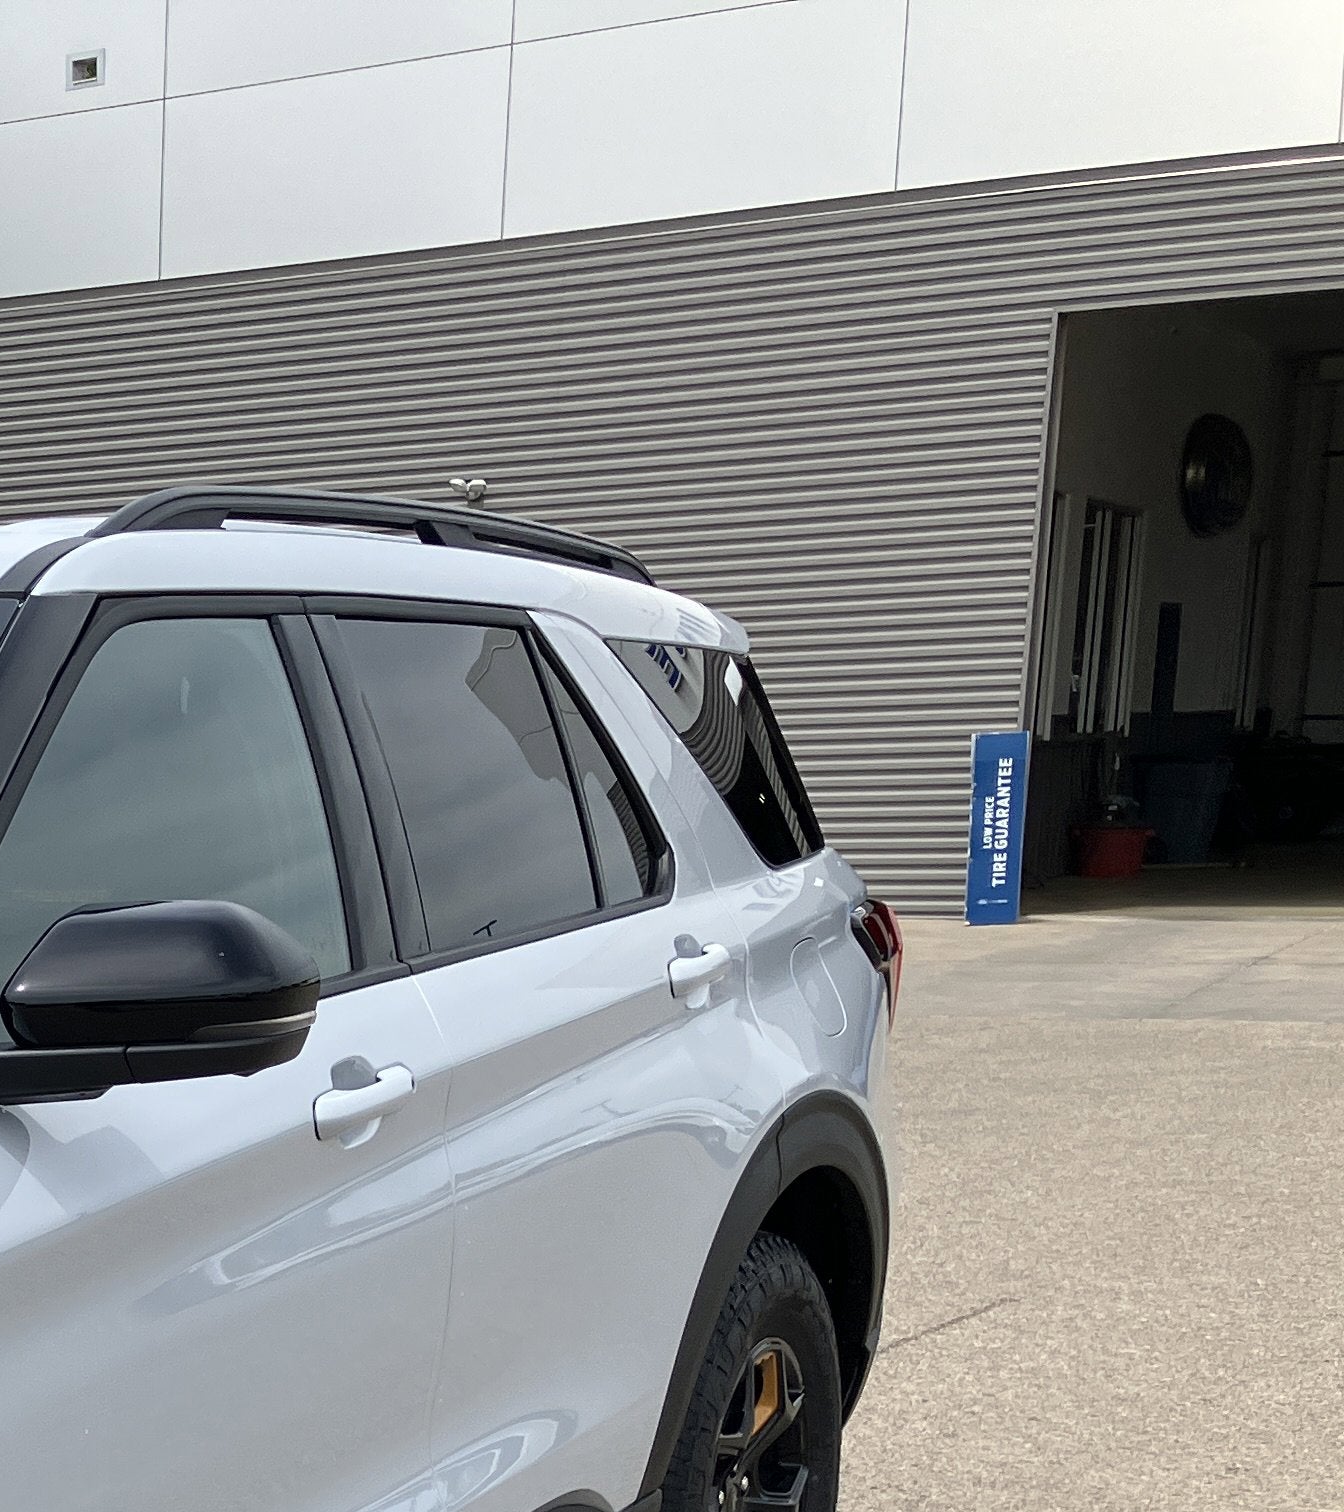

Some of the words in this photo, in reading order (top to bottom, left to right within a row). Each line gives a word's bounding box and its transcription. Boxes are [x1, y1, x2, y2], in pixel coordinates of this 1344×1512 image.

[984, 796, 995, 825] PRICE
[994, 757, 1013, 850] GUARANTEE
[983, 826, 993, 849] LOW
[991, 852, 1007, 888] TIRE
